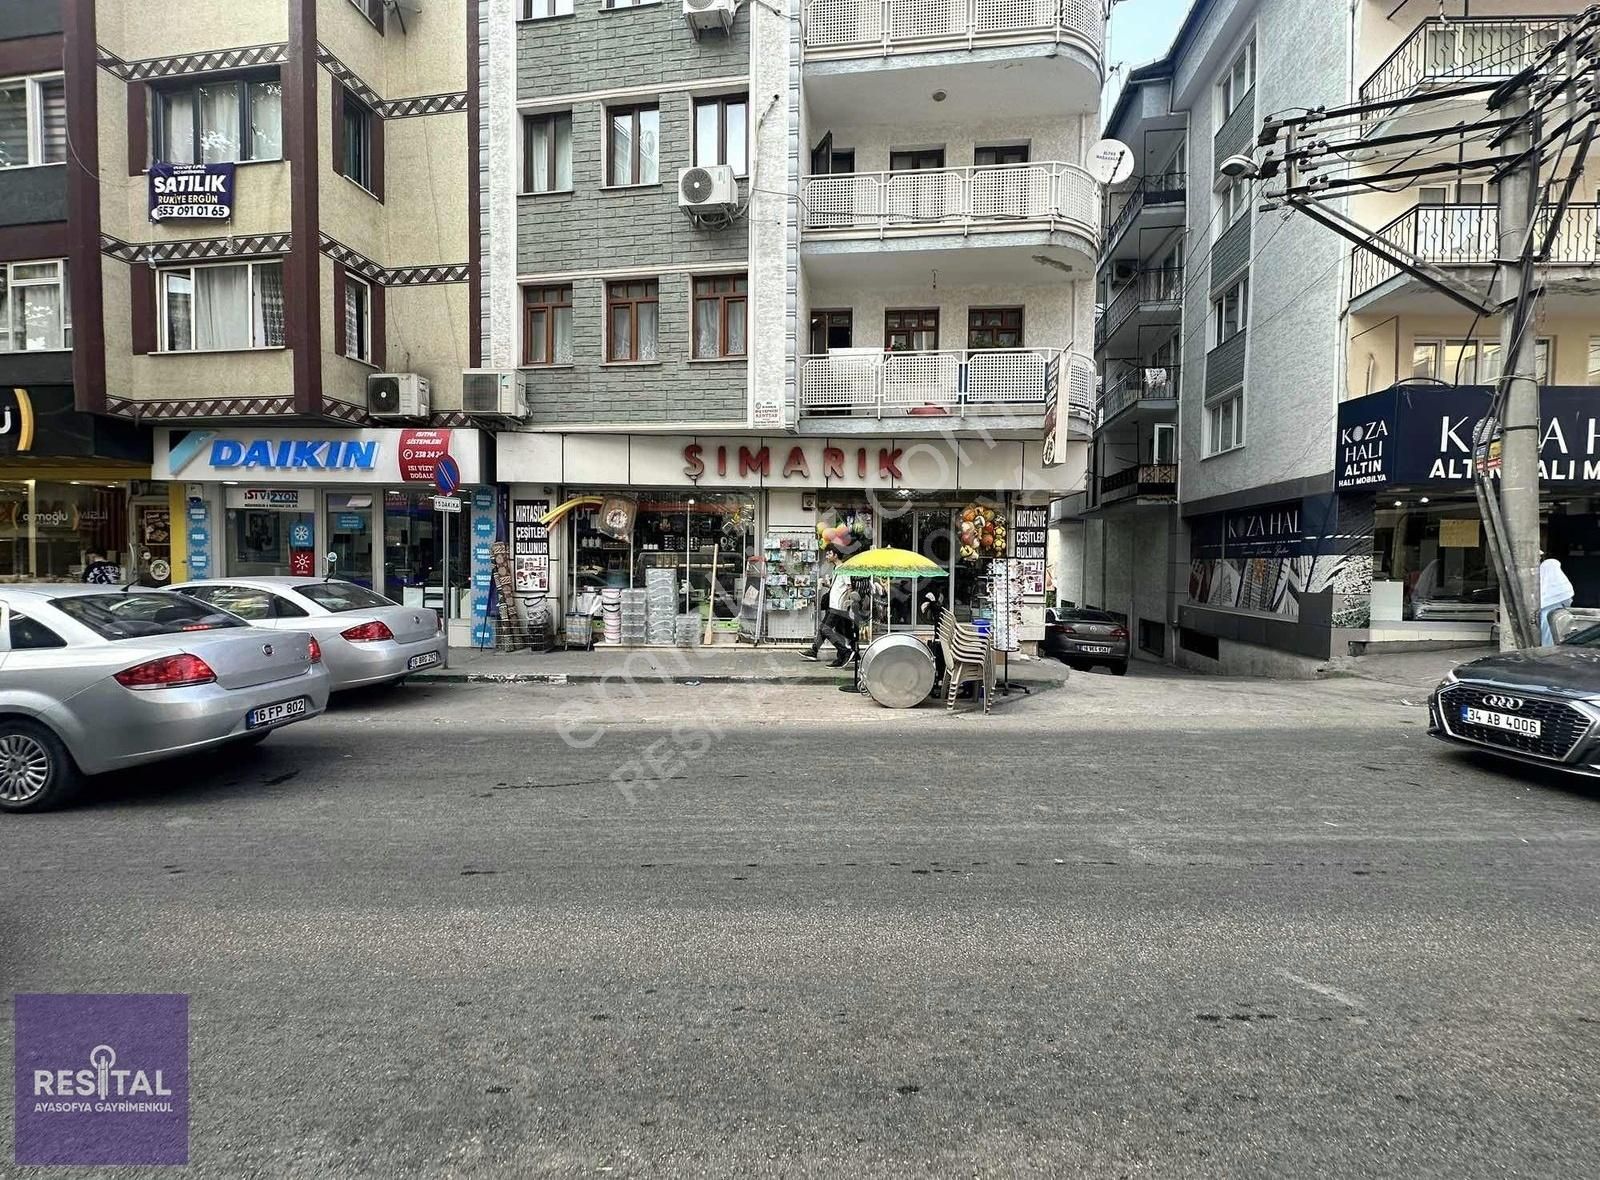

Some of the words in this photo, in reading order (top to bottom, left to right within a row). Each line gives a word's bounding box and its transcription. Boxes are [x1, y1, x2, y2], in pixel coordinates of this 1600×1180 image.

[154, 175, 226, 193] SATILIK
[188, 193, 218, 204] ERGÜN
[177, 206, 194, 215] 091
[197, 206, 208, 215] 01
[211, 206, 225, 216] 65
[1342, 420, 1388, 445] KOZA
[209, 439, 379, 469] DAIKIN
[1345, 440, 1383, 463] HALI
[684, 444, 904, 480] ŞIMARIK
[1344, 459, 1382, 477] ALTIN
[1338, 479, 1355, 488] HALI
[1017, 507, 1047, 528] KIRTASİYE
[1017, 530, 1046, 546] ÇEŞİTLERİ
[516, 542, 547, 554] BULUNUR
[1016, 546, 1045, 558] BULUNUR
[254, 710, 266, 722] 16
[268, 706, 283, 718] FP
[286, 699, 304, 713] 802
[1468, 709, 1481, 721] 34
[1487, 713, 1500, 725] AB
[1505, 716, 1537, 733] 4006
